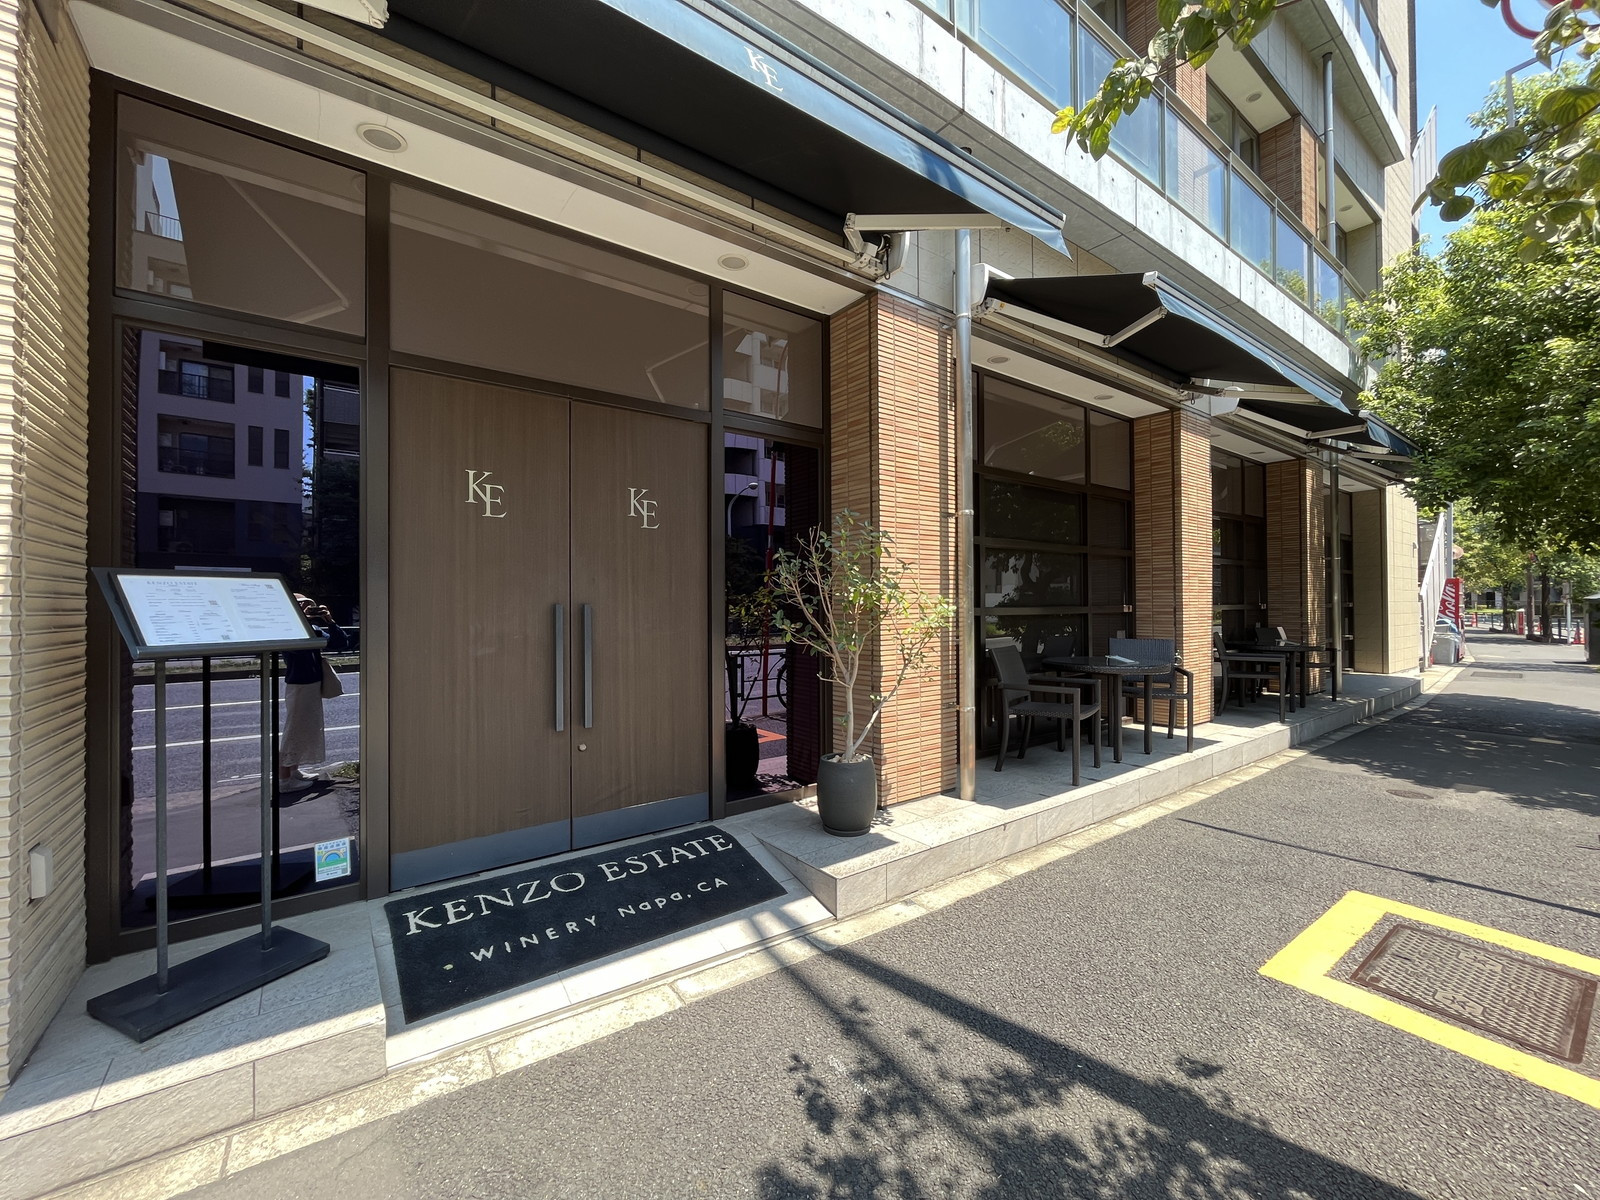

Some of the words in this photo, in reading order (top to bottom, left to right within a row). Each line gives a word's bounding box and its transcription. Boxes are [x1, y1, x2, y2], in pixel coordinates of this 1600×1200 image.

[743, 45, 784, 92] KE
[465, 469, 508, 518] KE
[627, 487, 660, 529] KE
[402, 872, 586, 936] KENZO
[598, 834, 733, 883] ESTATE
[470, 914, 597, 963] WINERY
